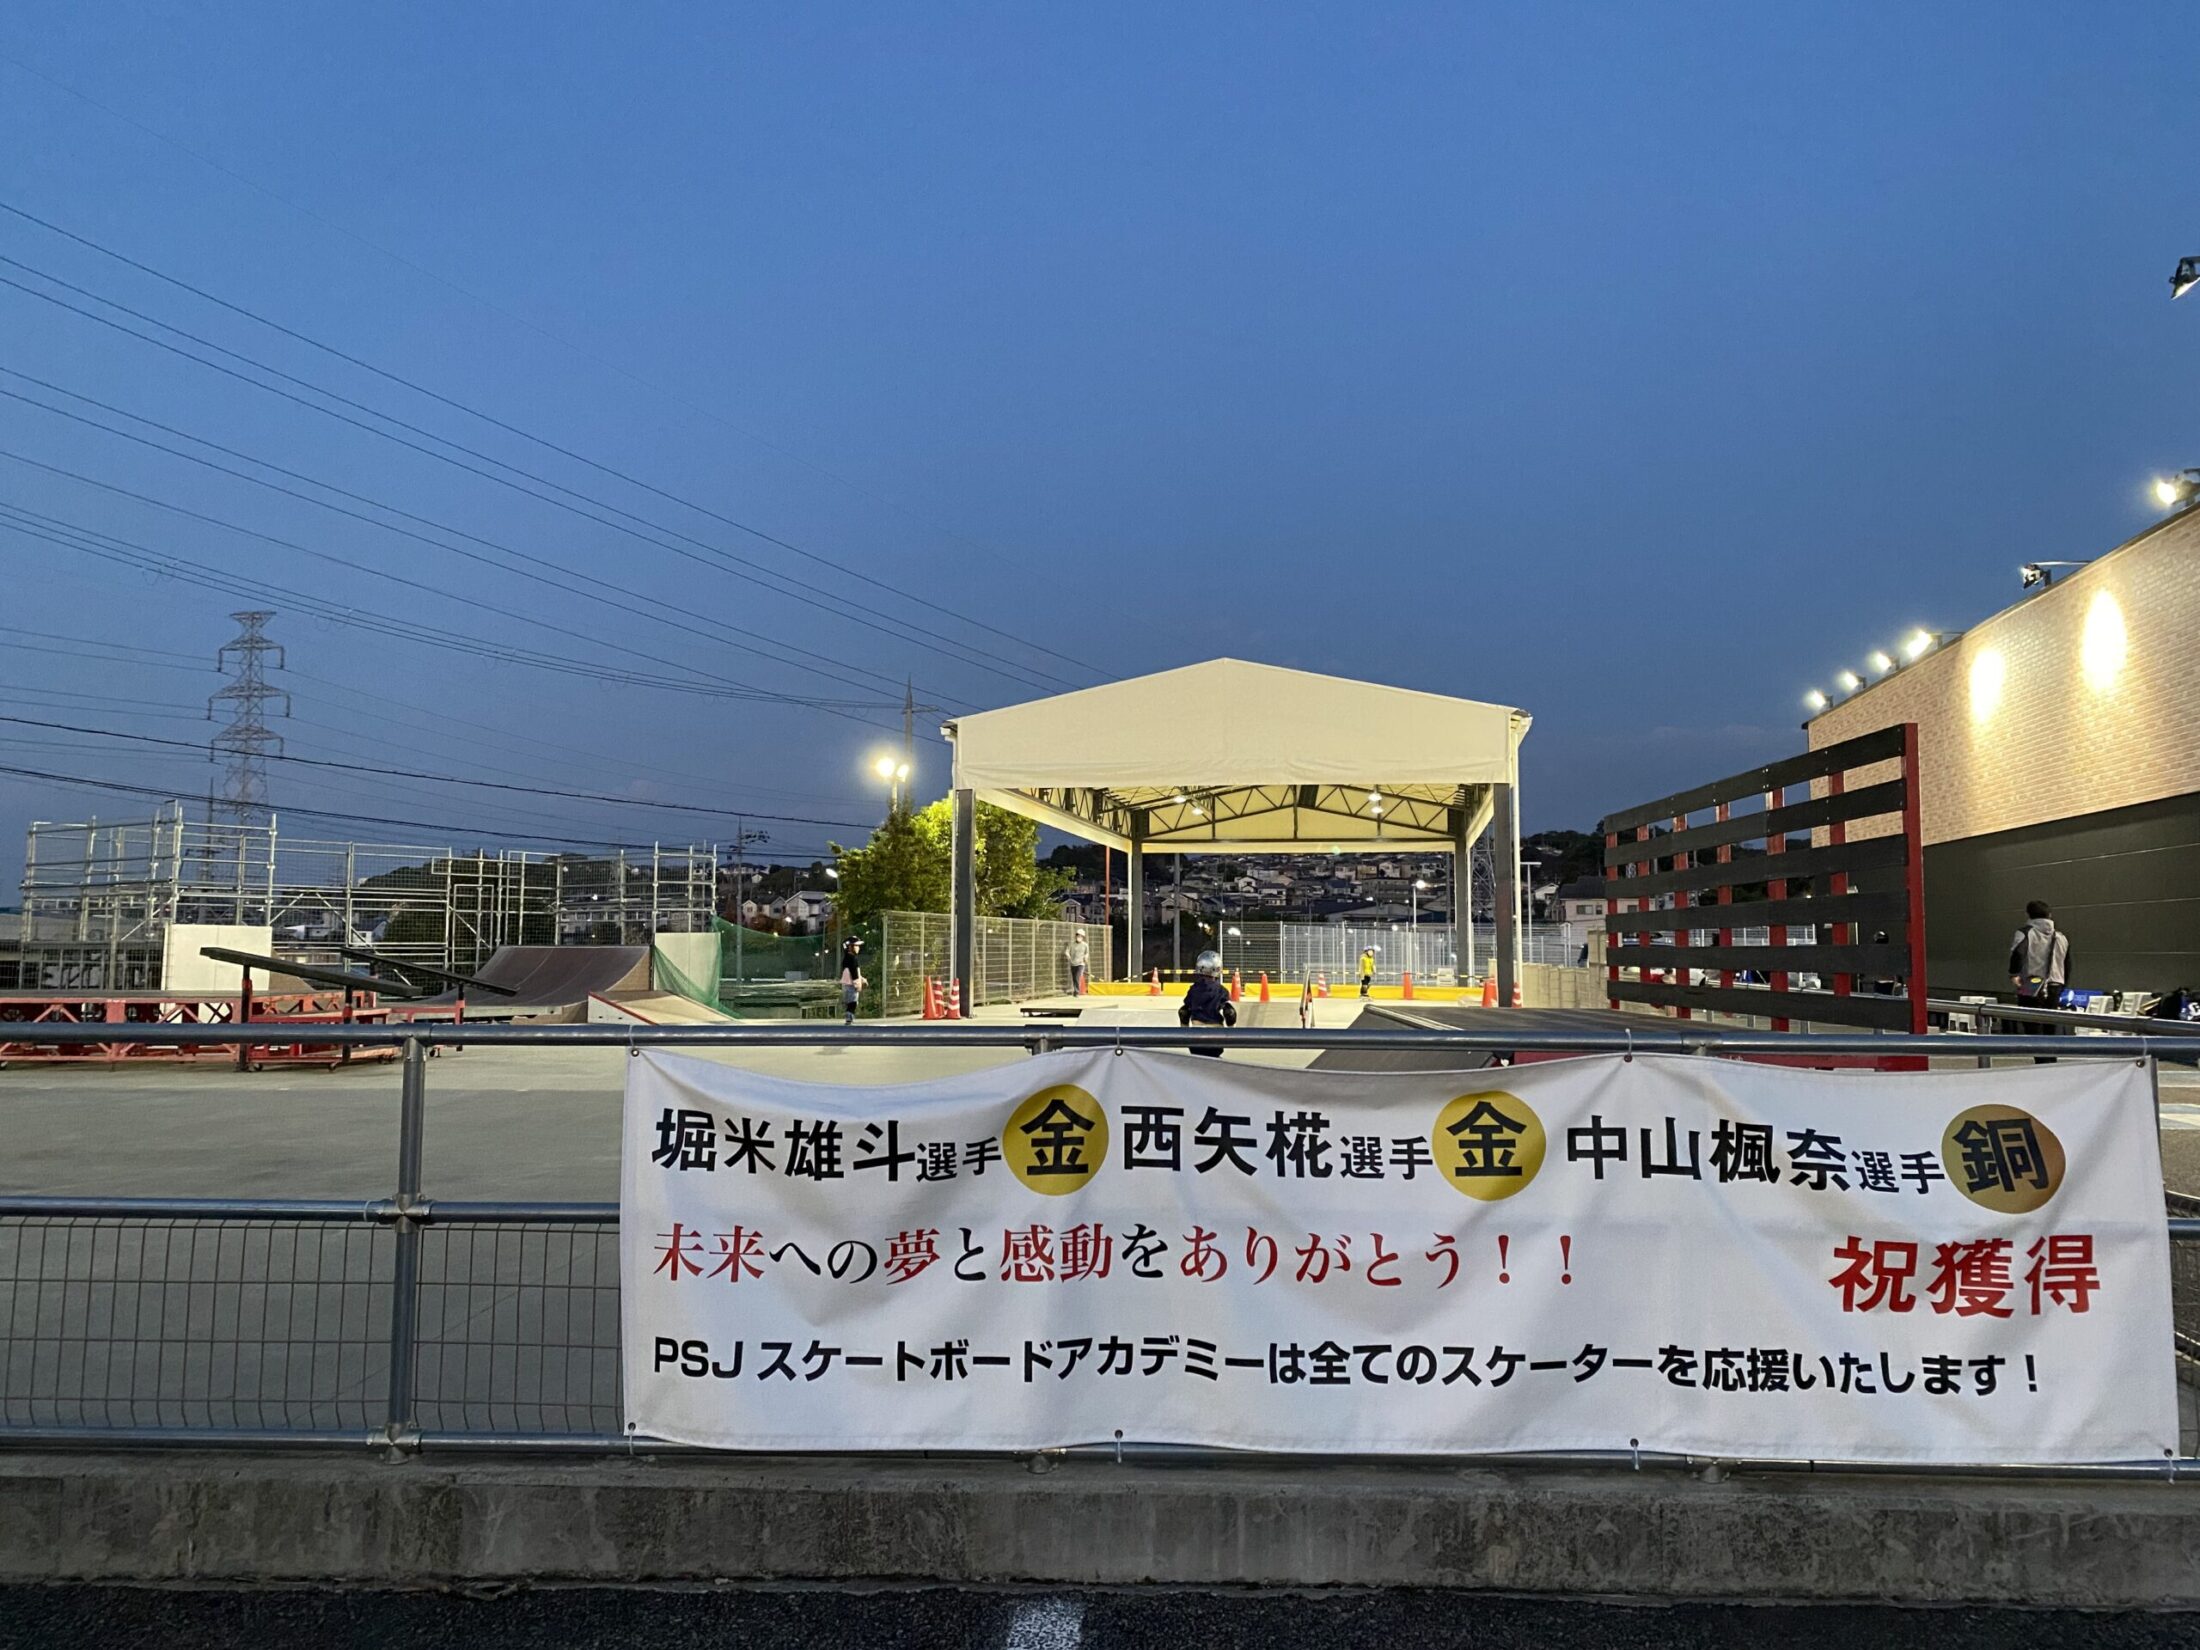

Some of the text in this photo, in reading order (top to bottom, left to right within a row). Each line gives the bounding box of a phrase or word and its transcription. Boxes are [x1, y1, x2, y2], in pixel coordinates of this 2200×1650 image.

[1020, 1098, 1096, 1176] 金
[1446, 1101, 1527, 1178] 金
[1952, 1117, 2049, 1194] 銅
[1828, 1234, 2101, 1319] 祝獲得
